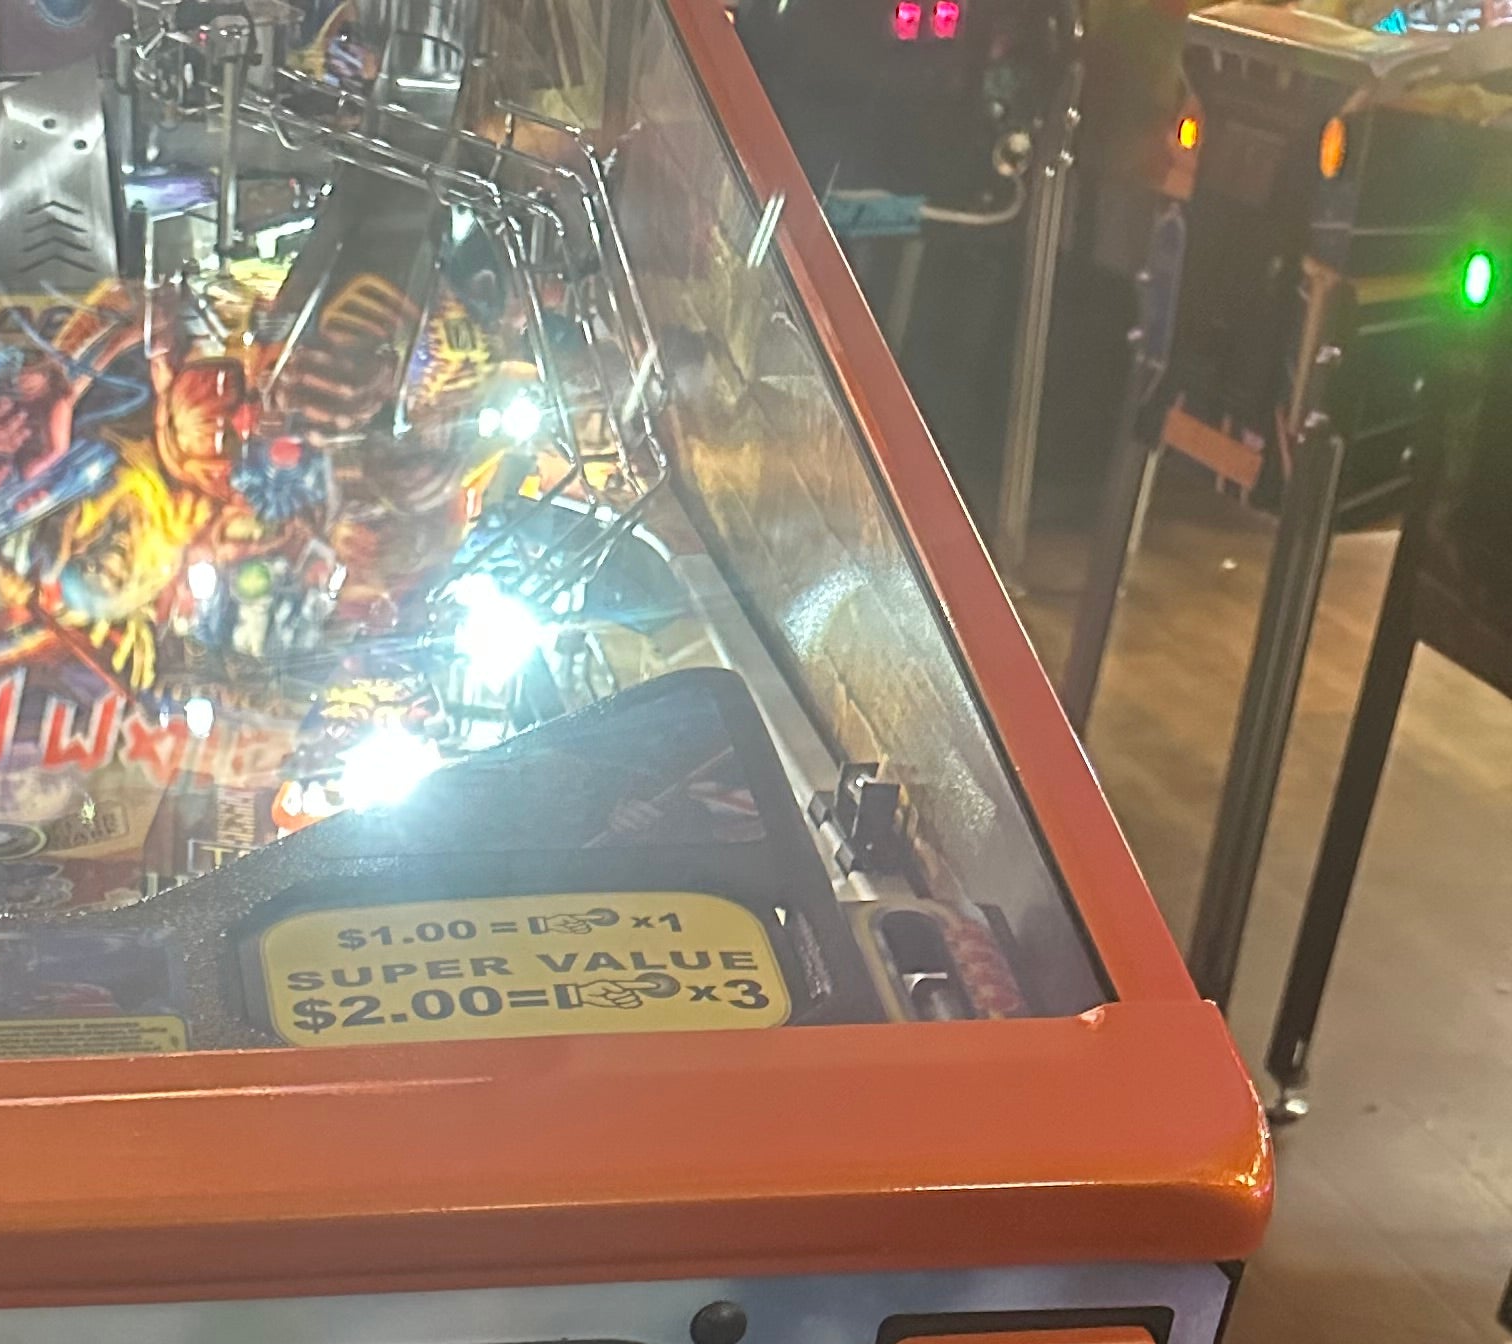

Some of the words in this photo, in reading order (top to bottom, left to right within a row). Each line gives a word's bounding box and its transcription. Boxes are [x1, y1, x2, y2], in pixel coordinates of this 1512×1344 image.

[336, 918, 476, 951] $1.00
[631, 912, 683, 935] x1
[287, 954, 512, 992] SUPER
[538, 950, 759, 974] VALUE
[688, 978, 770, 1011] x3
